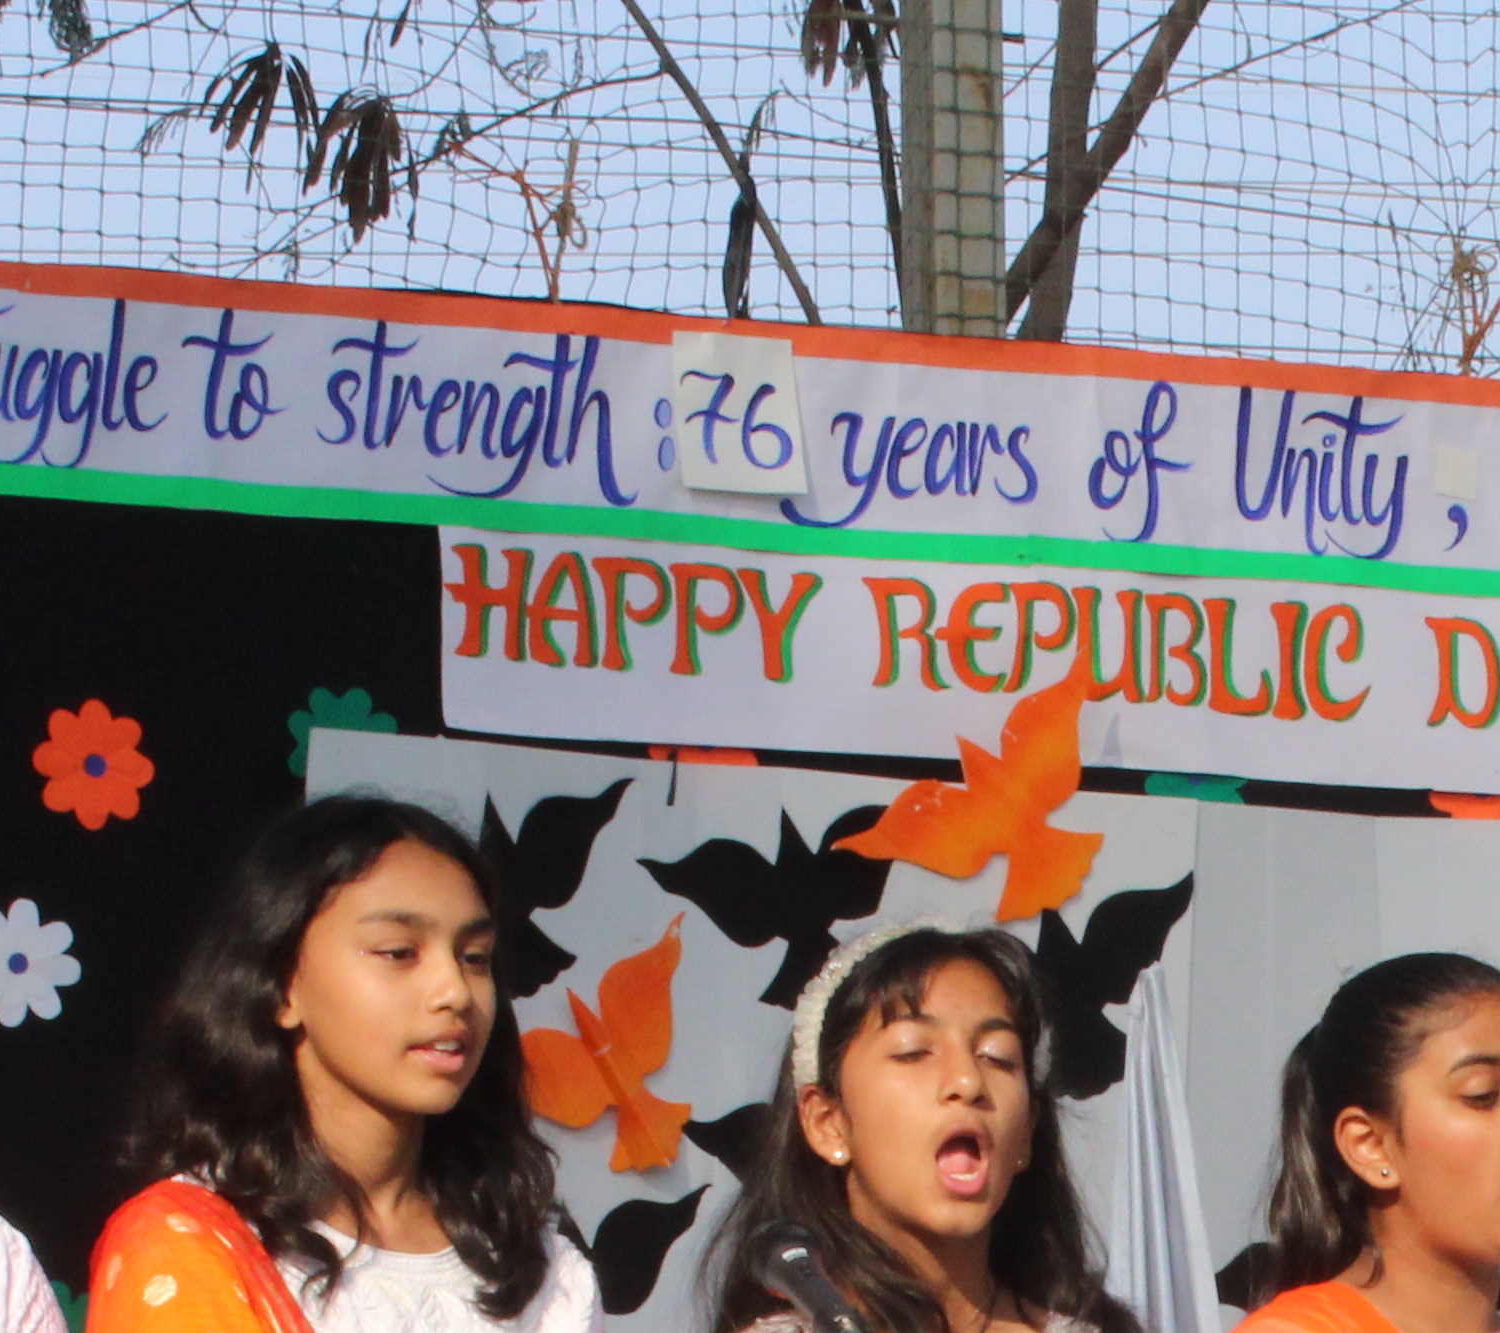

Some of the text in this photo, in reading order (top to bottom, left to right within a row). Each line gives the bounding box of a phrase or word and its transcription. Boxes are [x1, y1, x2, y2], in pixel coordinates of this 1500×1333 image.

[180, 305, 288, 441] to
[679, 370, 793, 470] 76
[781, 407, 1039, 528] years
[1088, 379, 1193, 543] of
[445, 541, 823, 683] HAPPY
[863, 577, 1373, 723] REPUBLIC
